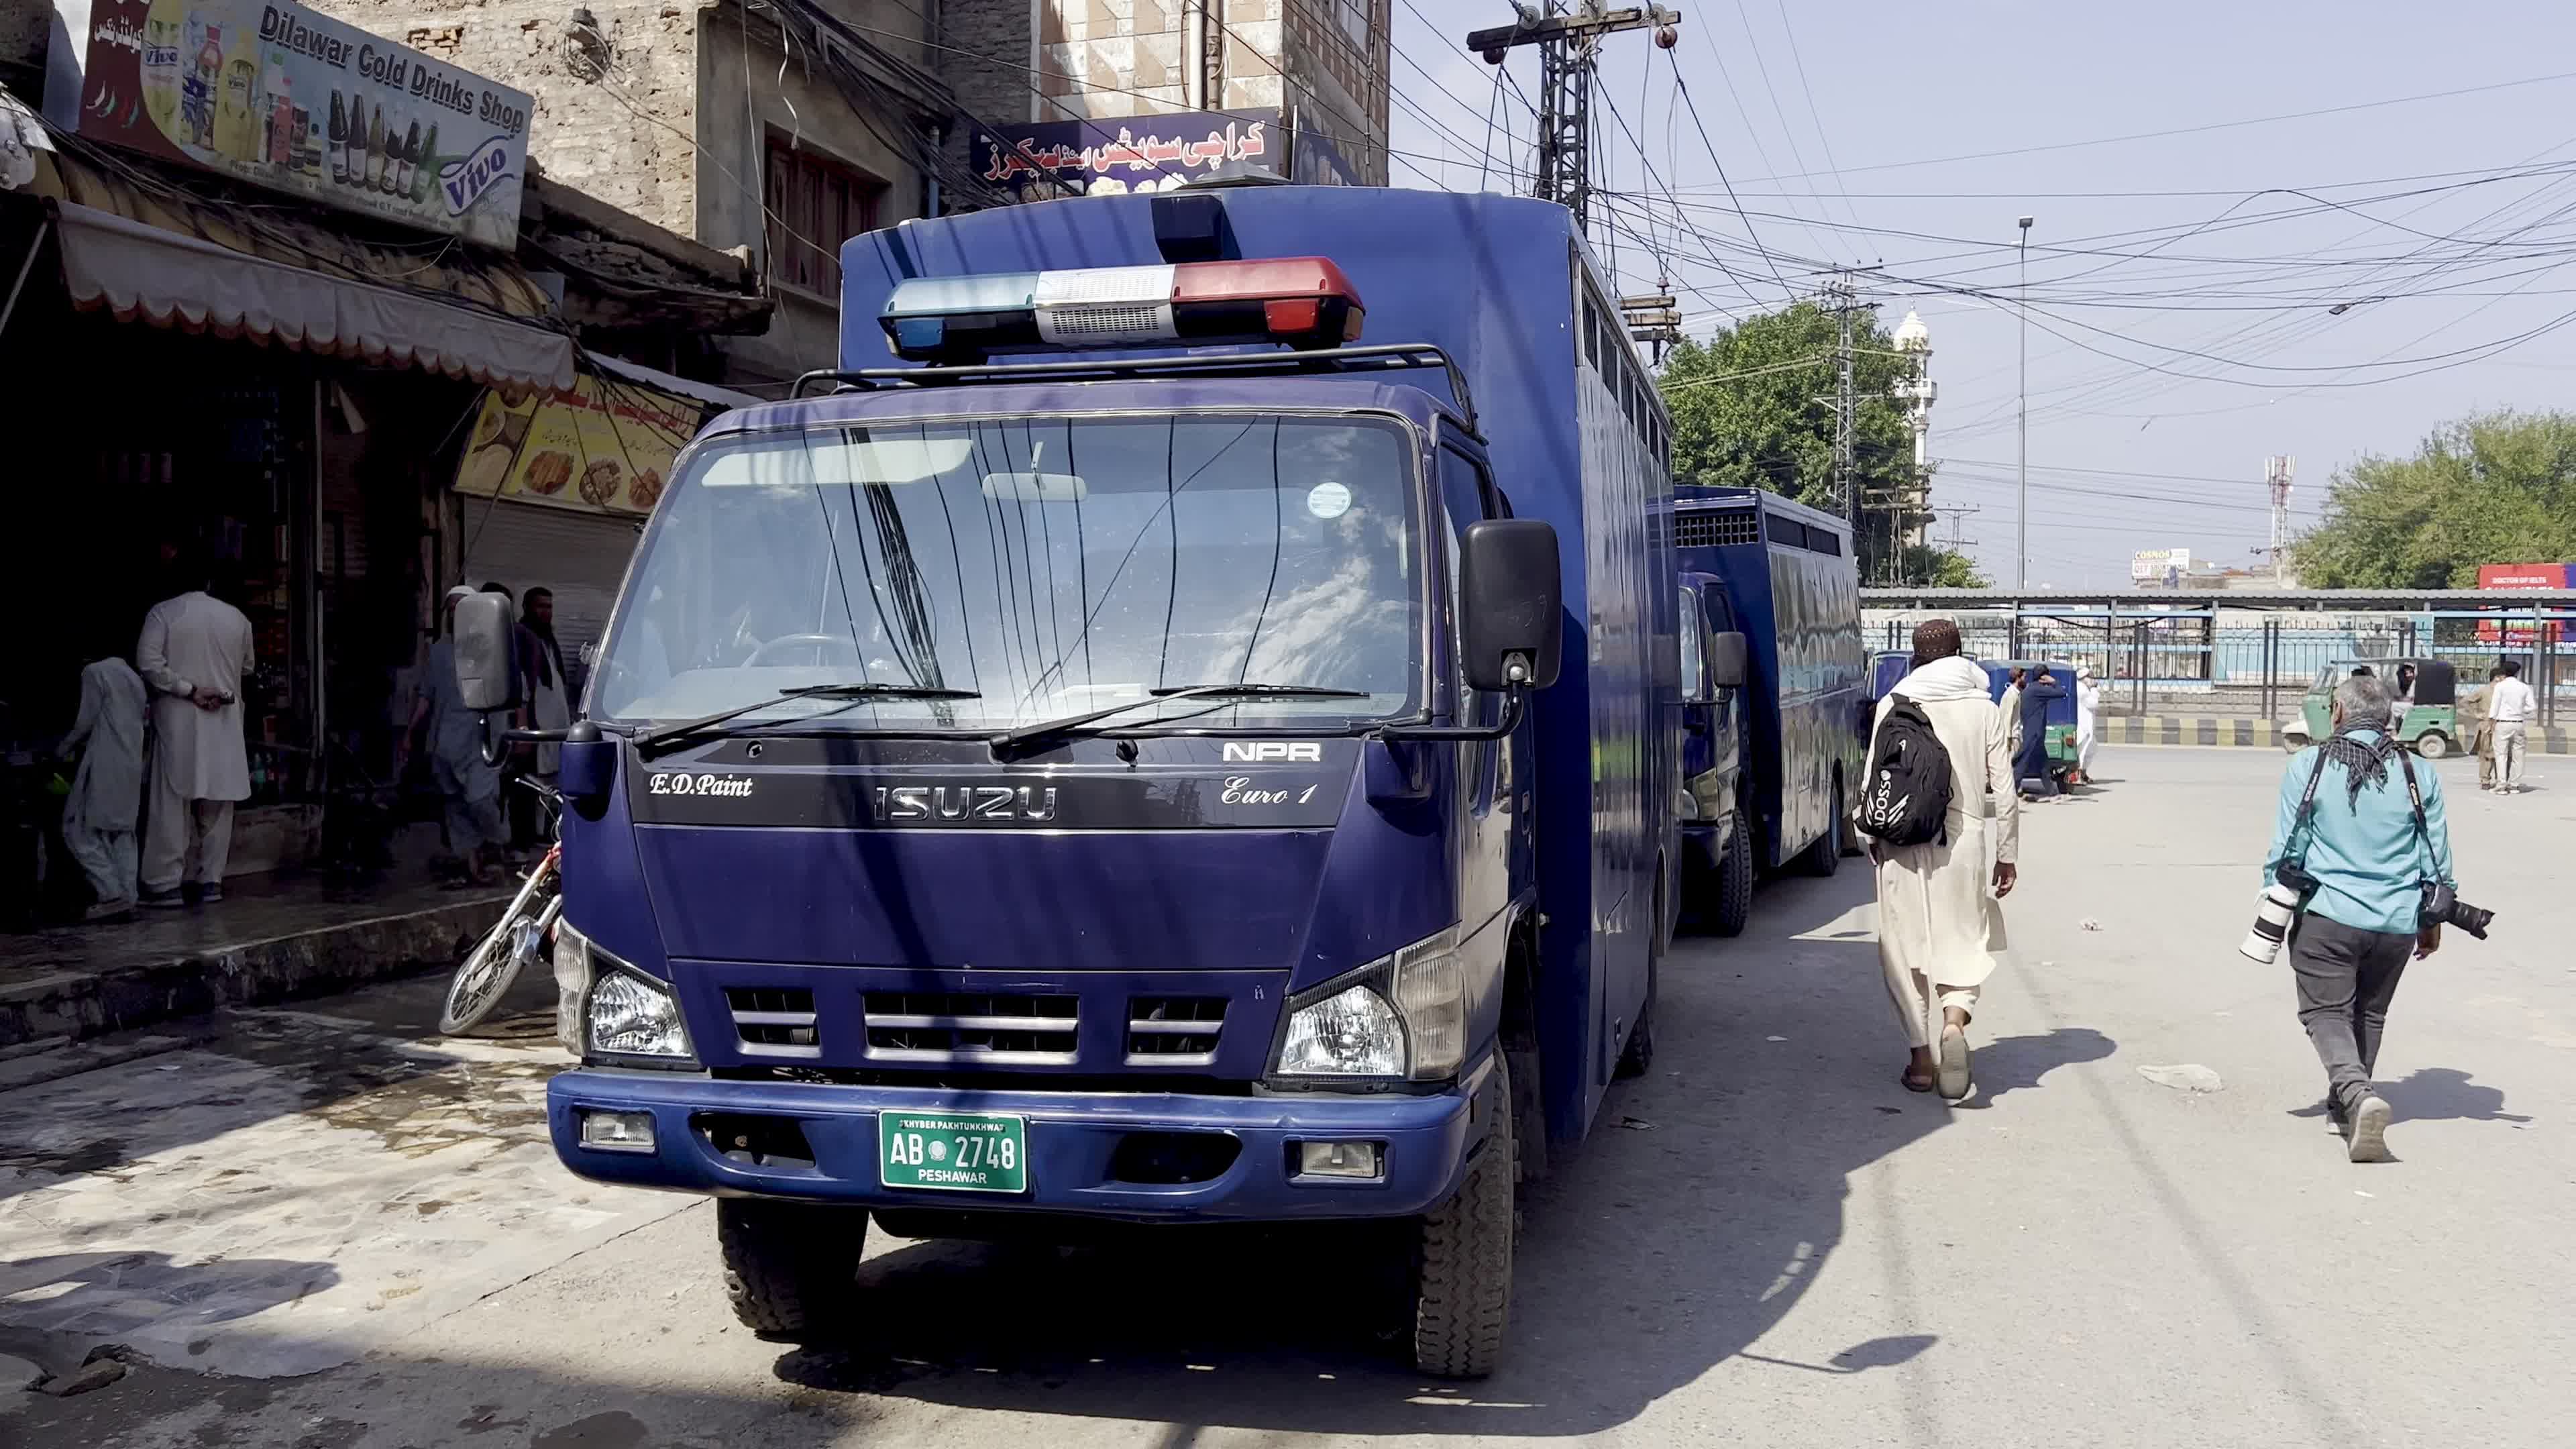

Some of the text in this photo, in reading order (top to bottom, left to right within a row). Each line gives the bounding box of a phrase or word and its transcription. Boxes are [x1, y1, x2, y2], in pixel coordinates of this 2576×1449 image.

[258, 5, 524, 136] Dilawar Cold Drinks Shop
[1061, 144, 1092, 170] اینڈ
[1092, 126, 1183, 172] سویٹس
[1182, 121, 1266, 170] کراچی
[446, 148, 506, 209] Vivo
[1222, 741, 1320, 762] NPR
[649, 773, 753, 798] E.D.Paint
[1221, 775, 1318, 804] Euro 1
[875, 786, 1058, 822] ISUZU
[904, 1120, 1000, 1132] KHYBER PAKHTUNKHWA
[890, 1132, 1016, 1169] AB 2748
[918, 1169, 987, 1184] PESHAWAR
